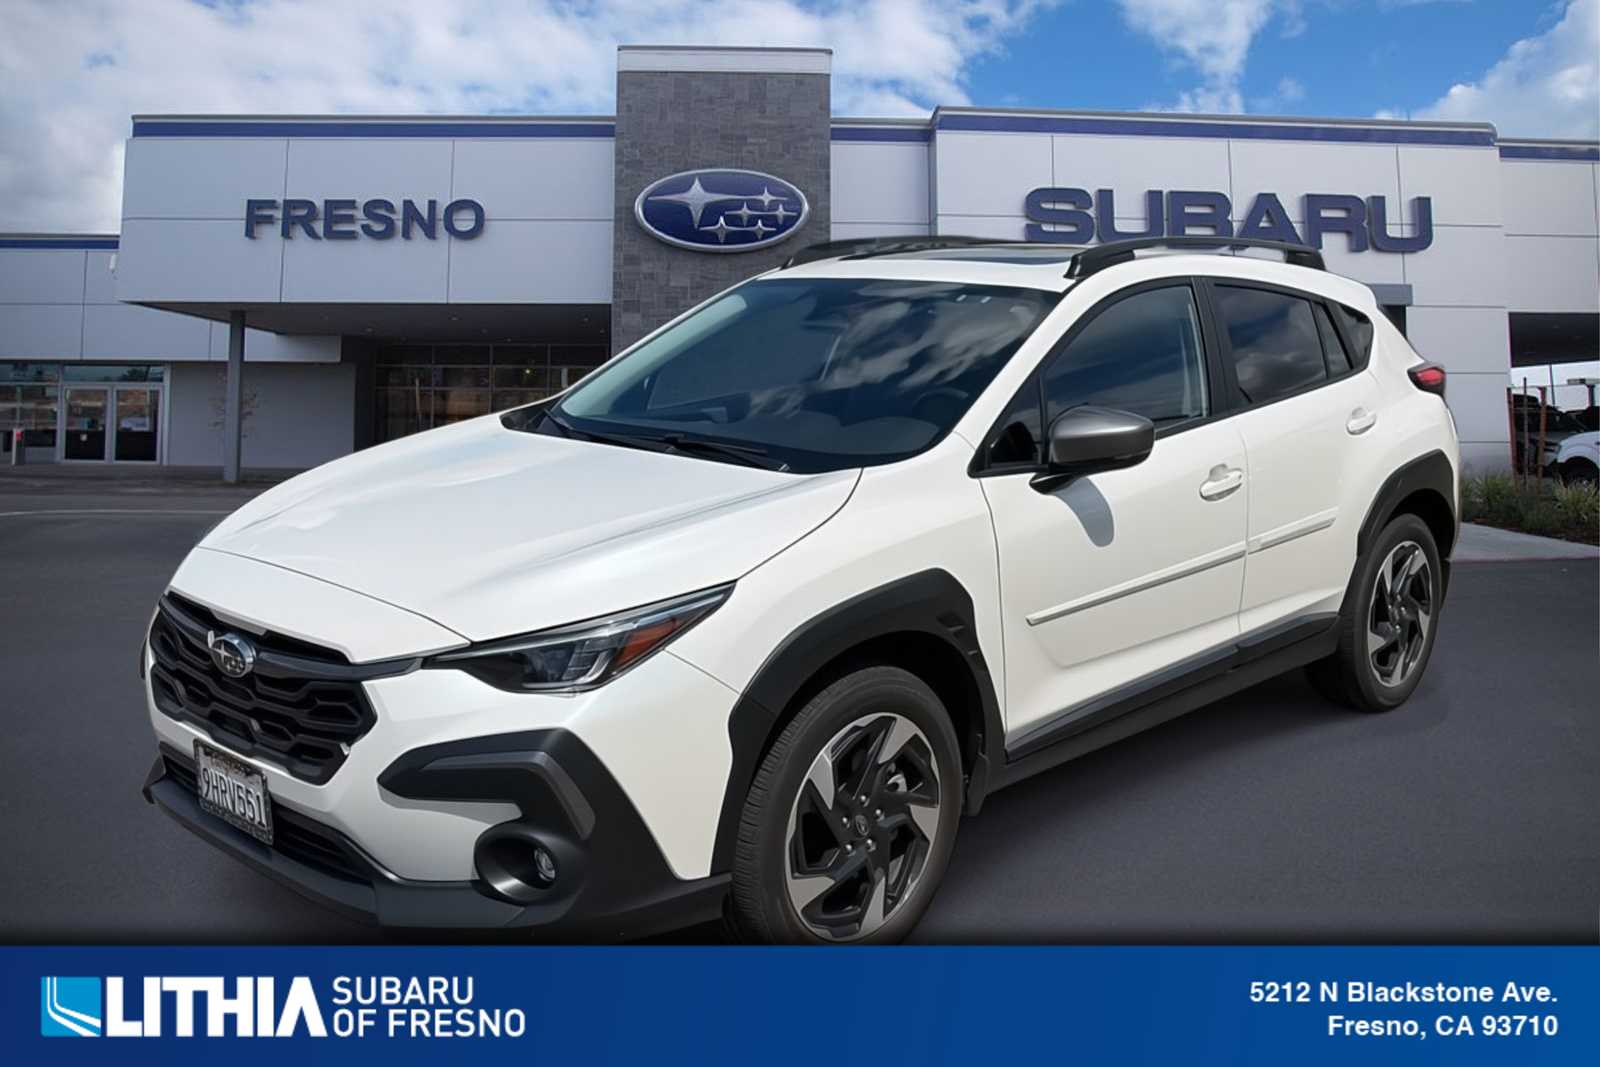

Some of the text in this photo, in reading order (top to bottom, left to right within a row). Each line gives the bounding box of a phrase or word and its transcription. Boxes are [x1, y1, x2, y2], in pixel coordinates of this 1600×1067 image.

[245, 199, 486, 241] FRESNO
[1024, 187, 1433, 254] SUBARU
[202, 767, 266, 829] 9HRV551
